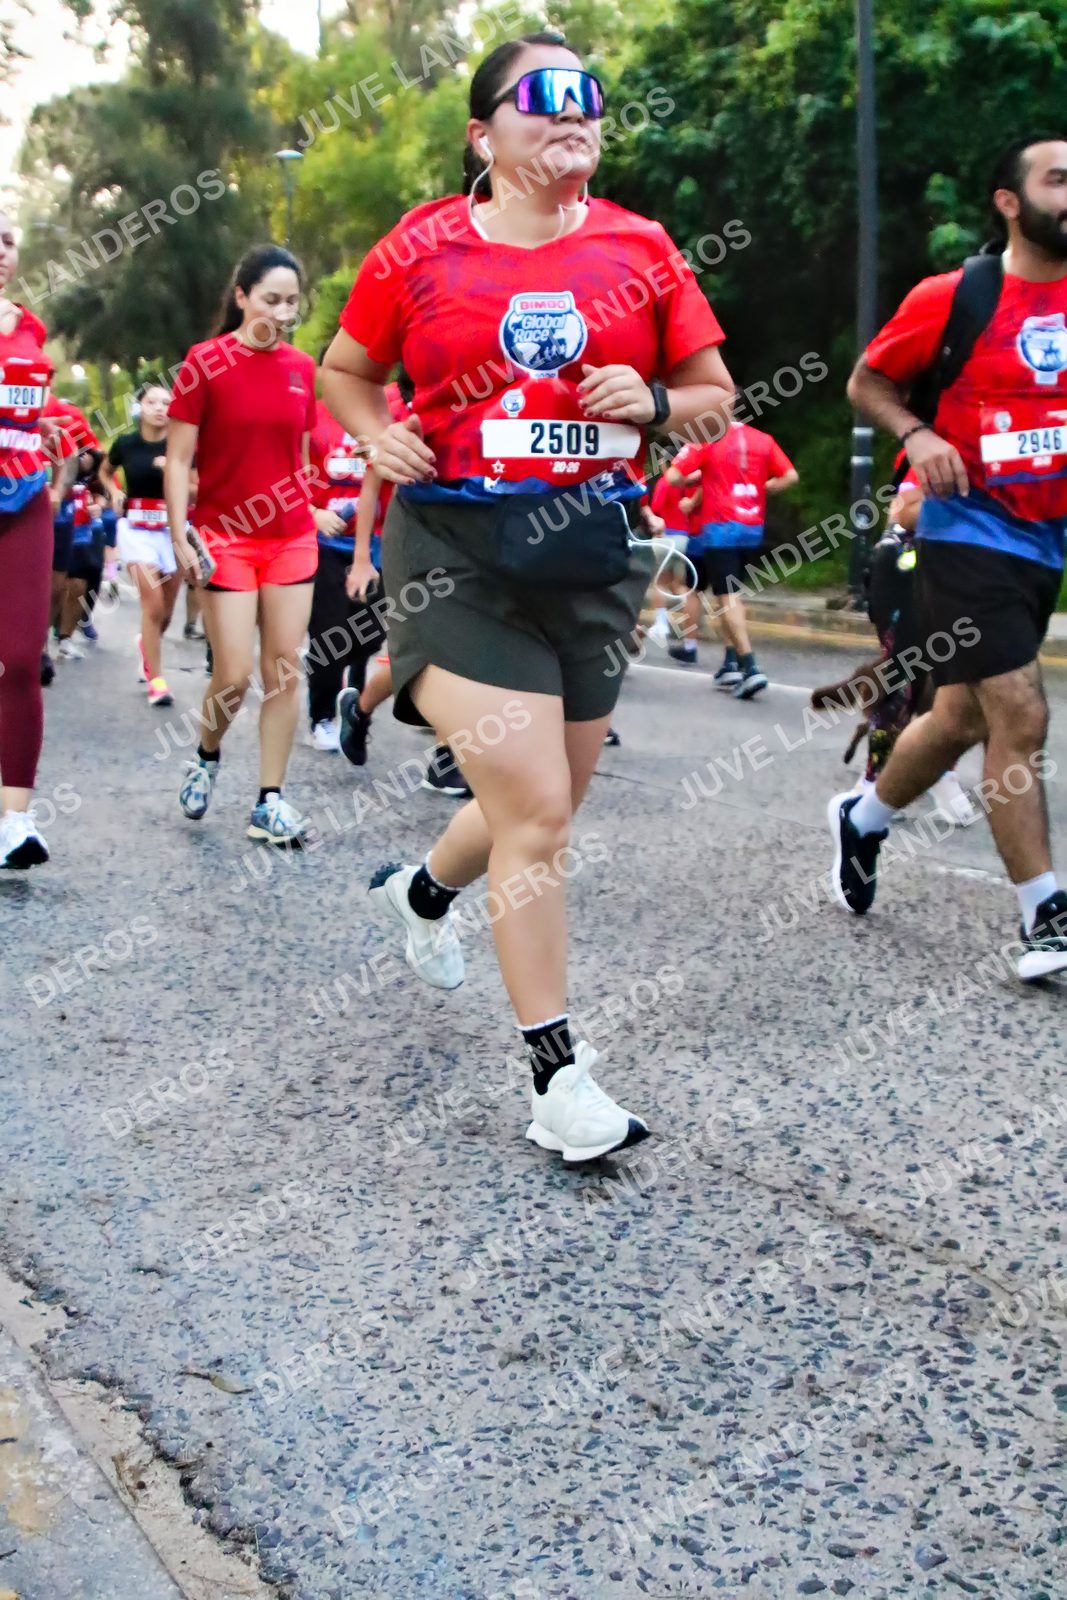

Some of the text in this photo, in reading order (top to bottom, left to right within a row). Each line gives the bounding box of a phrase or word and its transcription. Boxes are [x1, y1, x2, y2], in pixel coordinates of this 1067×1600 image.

[521, 314, 567, 329] Global
[513, 329, 550, 343] Race
[530, 422, 600, 456] 2509
[1018, 428, 1062, 454] 2946
